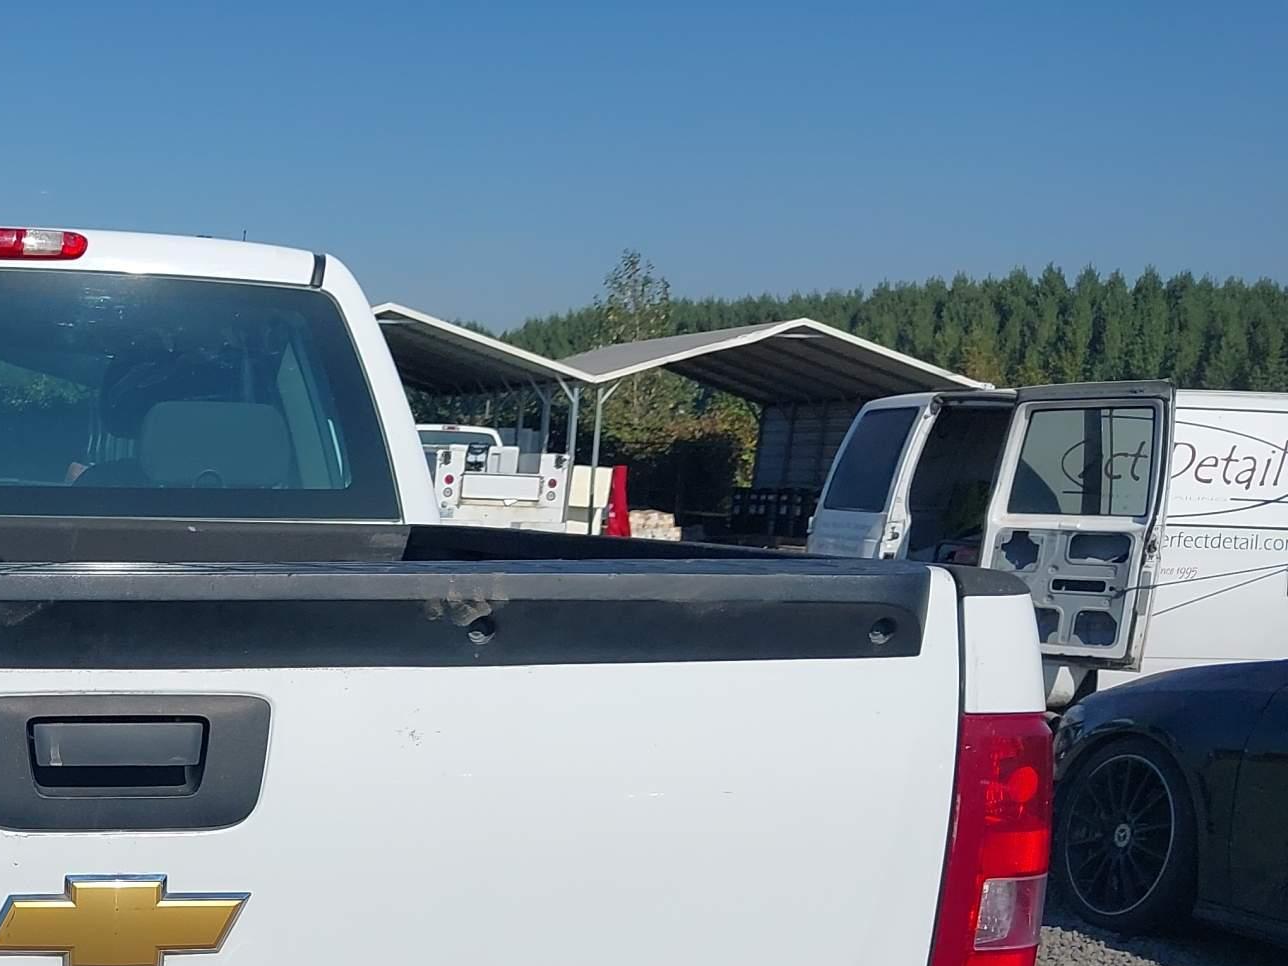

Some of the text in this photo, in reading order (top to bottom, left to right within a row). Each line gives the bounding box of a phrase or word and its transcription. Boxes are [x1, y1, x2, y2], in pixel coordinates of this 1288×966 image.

[1171, 439, 1288, 491] Detail
[1162, 531, 1288, 551] erfectdetail.co
[1176, 565, 1199, 580] 1995
